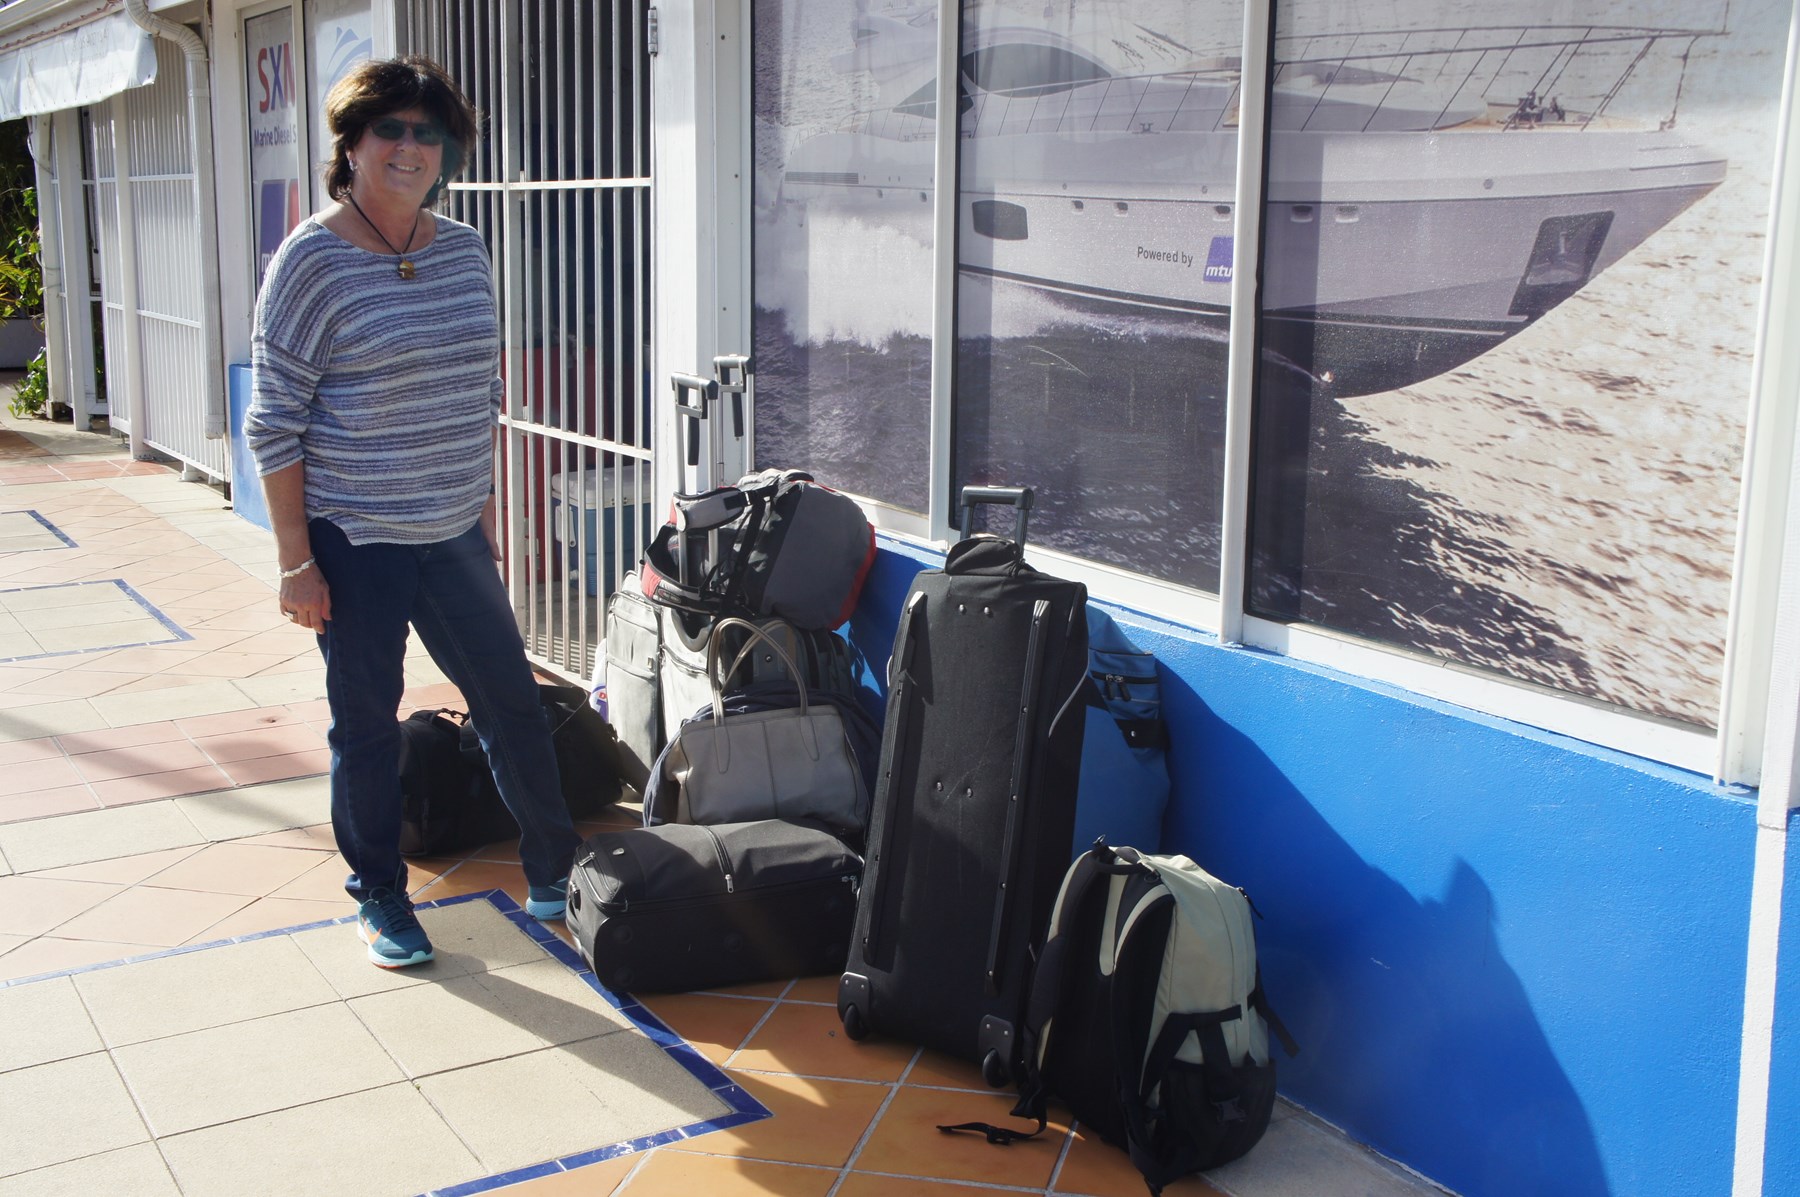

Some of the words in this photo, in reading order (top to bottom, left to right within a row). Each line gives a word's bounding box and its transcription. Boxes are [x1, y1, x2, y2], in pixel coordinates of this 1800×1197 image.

[254, 127, 273, 147] Marine
[273, 124, 291, 146] Diesel
[1137, 246, 1178, 263] Powered
[1181, 251, 1194, 268] by
[1205, 265, 1233, 278] mtu
